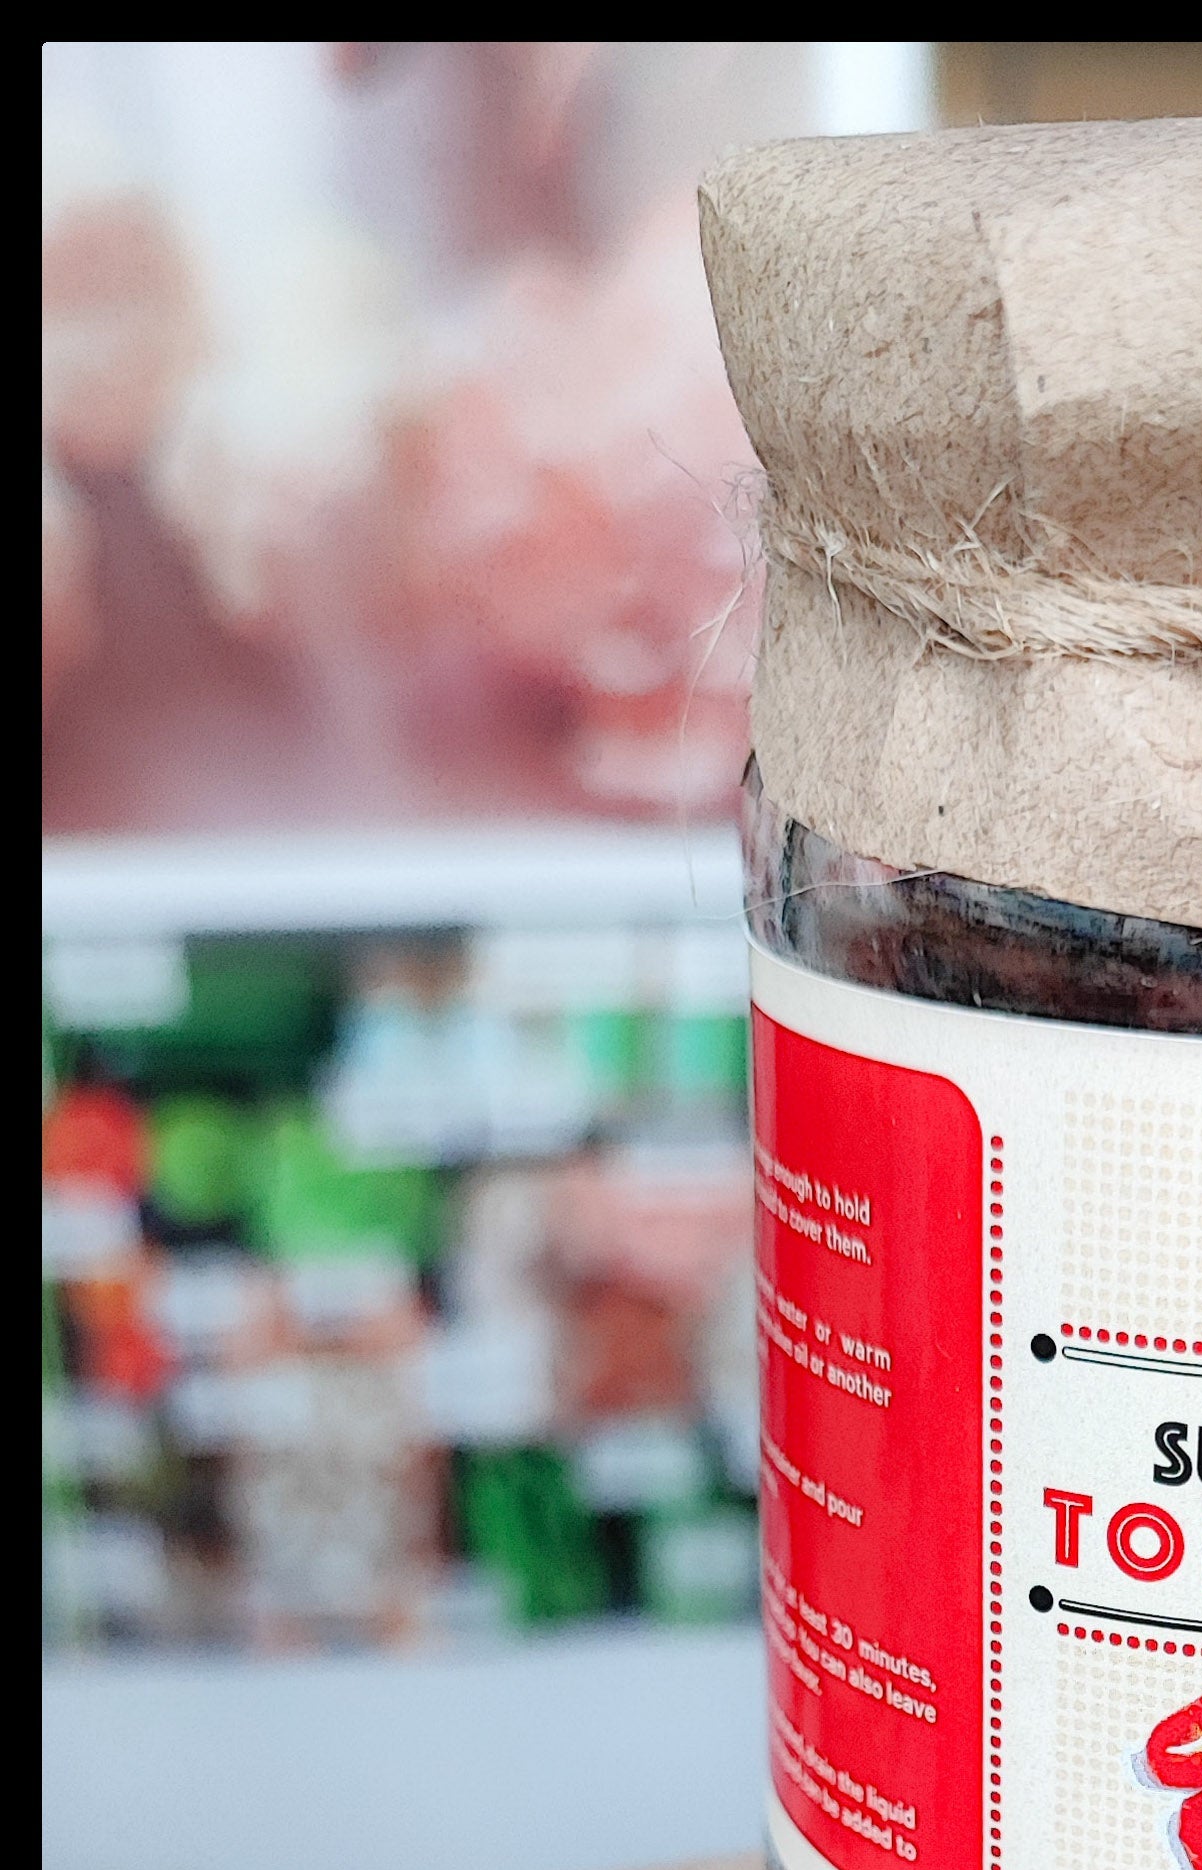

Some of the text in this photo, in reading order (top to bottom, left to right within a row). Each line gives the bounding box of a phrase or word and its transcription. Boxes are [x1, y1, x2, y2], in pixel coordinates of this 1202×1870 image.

[814, 1177, 831, 1210] to
[833, 1184, 870, 1226] hold
[789, 1205, 822, 1244] cover
[825, 1223, 871, 1265] them.
[814, 1319, 831, 1345] or
[839, 1332, 891, 1371] warm
[827, 1362, 891, 1408] another
[827, 1491, 863, 1528] pour
[858, 1638, 937, 1693] minutes,
[848, 1666, 883, 1700] also
[886, 1680, 937, 1723] leave
[866, 1784, 916, 1830] liquid
[841, 1807, 893, 1850] added
[896, 1835, 917, 1861] to
